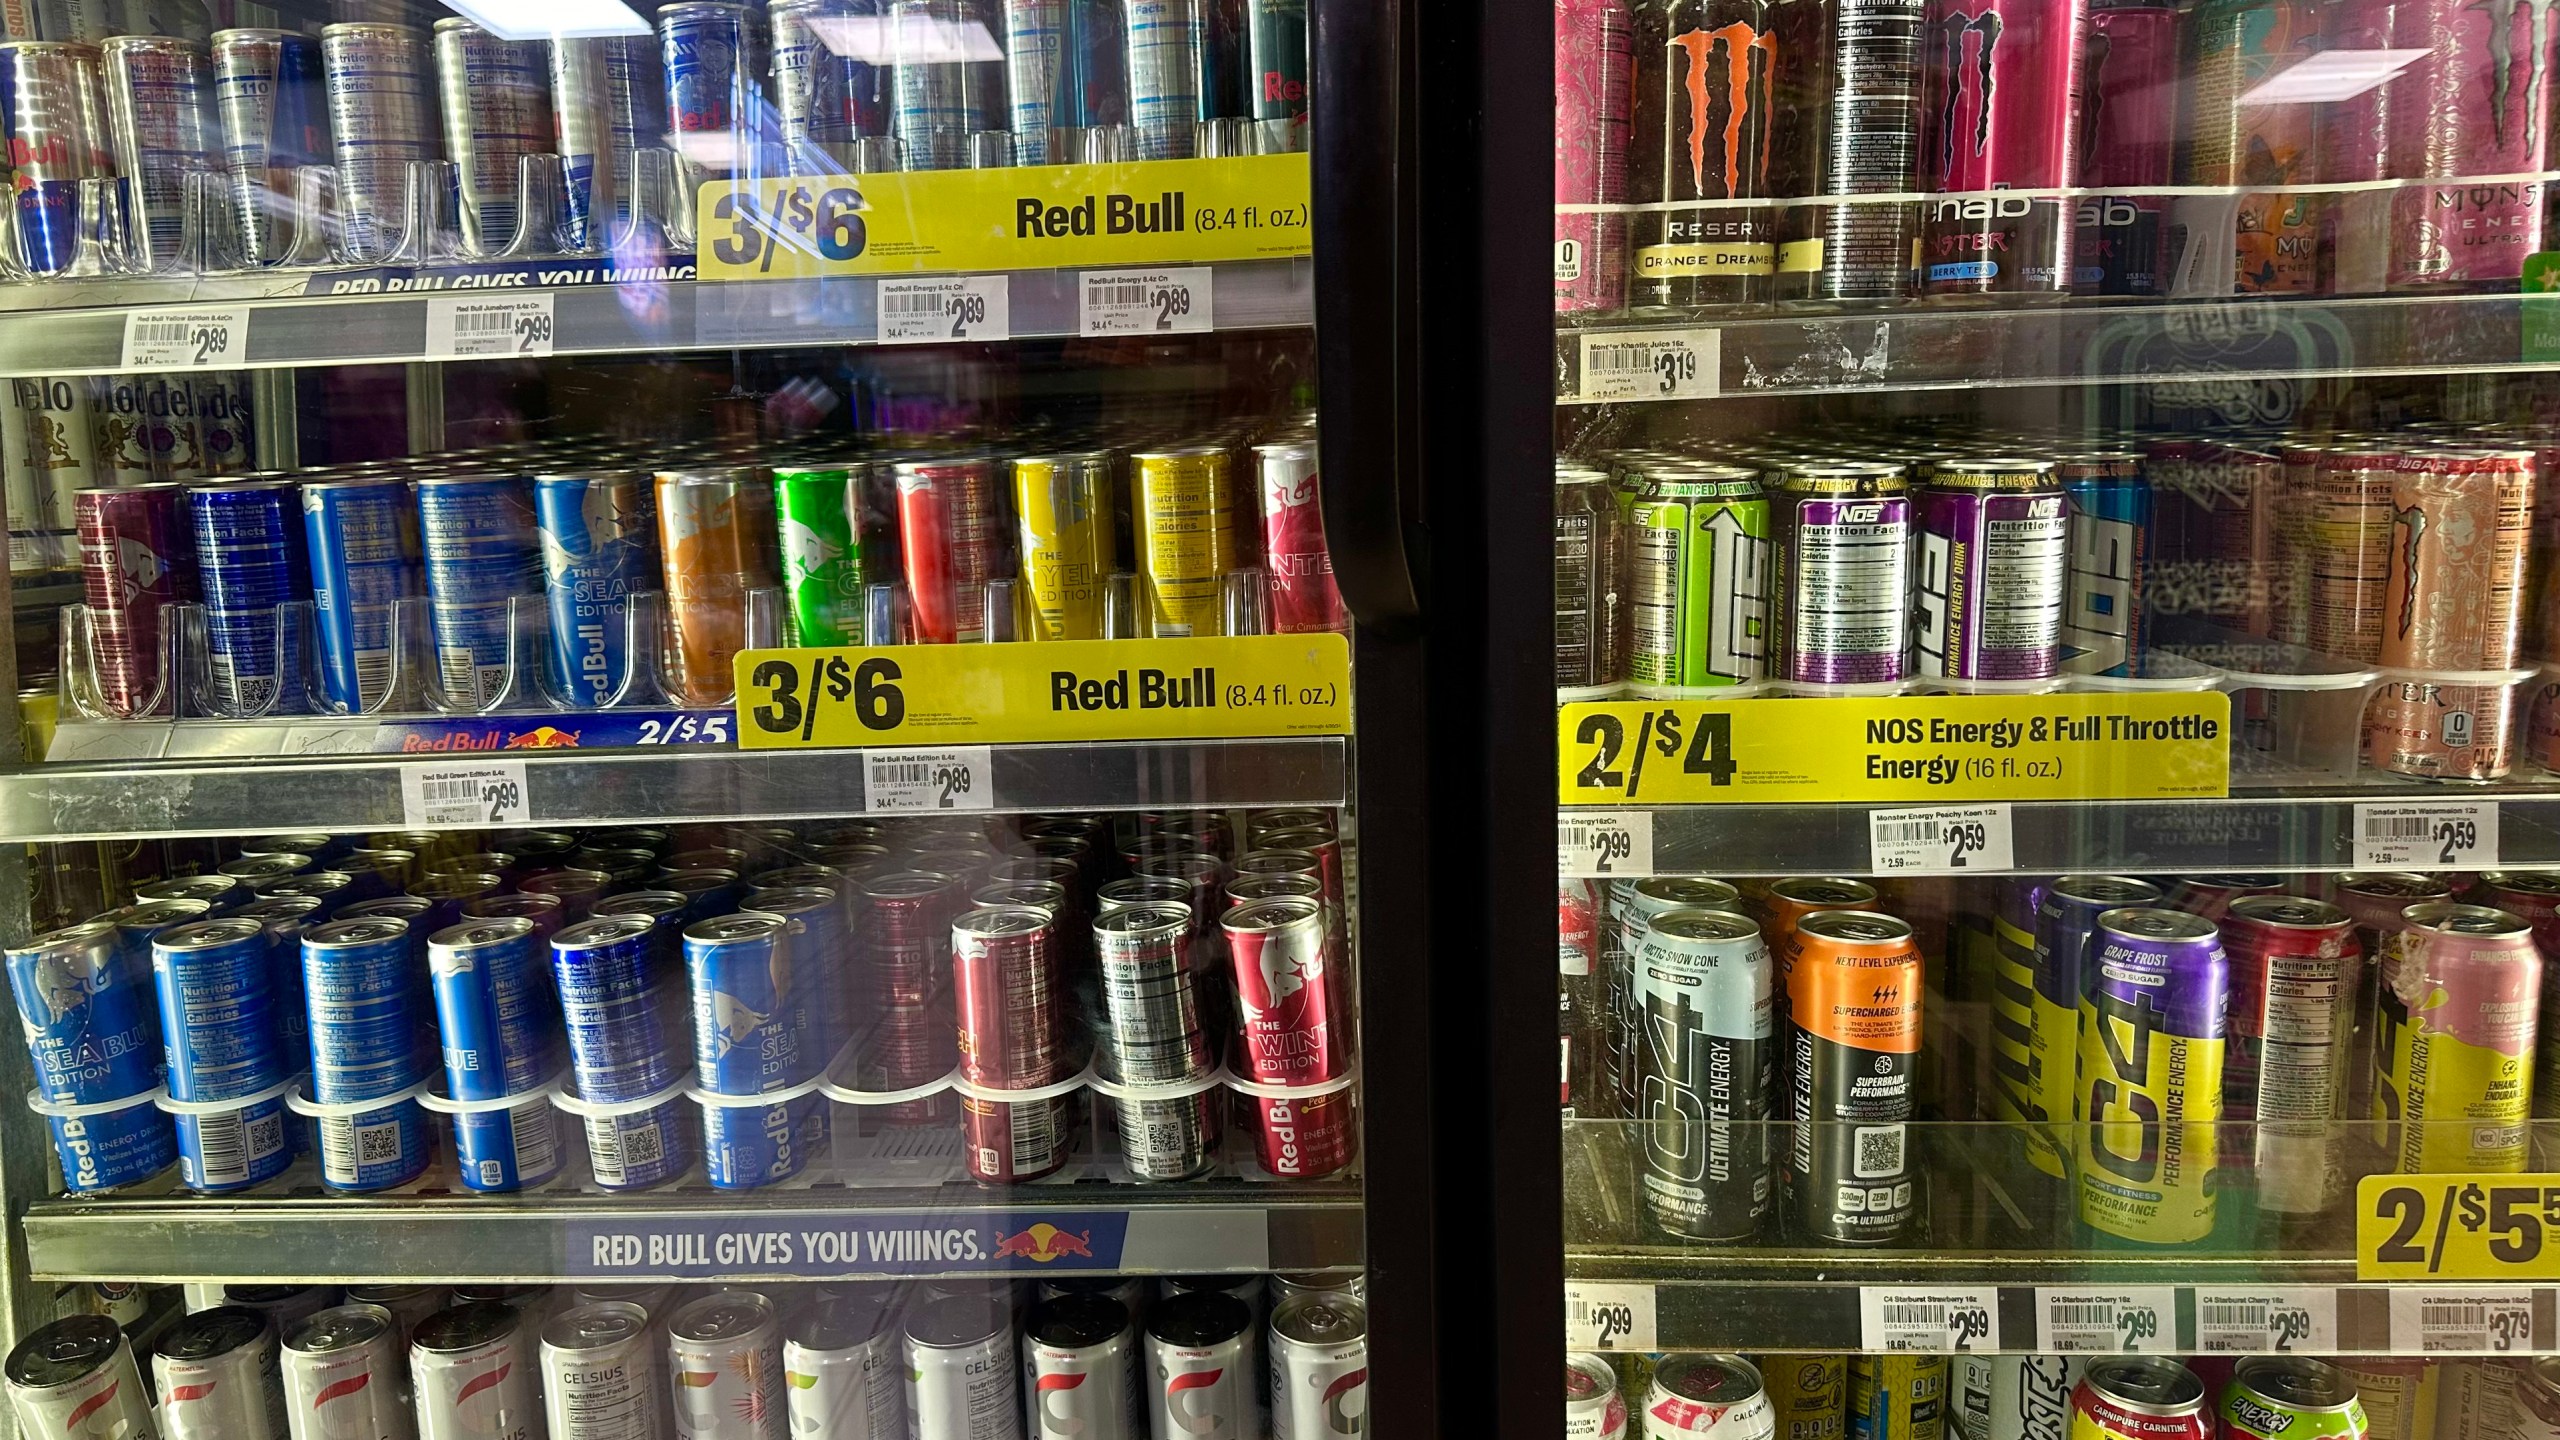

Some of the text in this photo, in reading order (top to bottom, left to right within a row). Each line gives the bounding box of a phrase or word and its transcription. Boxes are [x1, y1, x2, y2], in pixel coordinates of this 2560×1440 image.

[1017, 192, 1308, 238] Red Bull (8.4 fl. oz.)
[713, 186, 866, 272] 3/$6
[1645, 256, 1708, 267] ORANGE
[1934, 266, 1989, 276] BERRY TEA
[1658, 482, 1755, 496] ENHANCED MENTAL
[1813, 479, 1858, 492] ENERGY
[1997, 474, 2039, 487] ENERGY
[1838, 506, 1880, 523] NOS
[1038, 552, 1063, 560] THE
[1802, 552, 1829, 560] Calories
[572, 568, 600, 577] THE
[1952, 542, 1966, 619] ENERGY DRINK
[575, 579, 628, 602] SEA
[753, 656, 905, 741] 3/$6
[1051, 668, 1336, 711] Red Bull (8.4 fl. oz.)
[1866, 714, 2218, 748] NOS Energy & Full Throttle
[1576, 710, 1737, 797] 2/$4
[1866, 754, 2062, 784] Energy (16 fl. oz.)
[1643, 942, 1720, 967] ARCTIC SNOW CONE
[1835, 956, 1857, 967] NEXT
[1859, 957, 1882, 968] LEVEL
[2104, 944, 2168, 966] GRAPE FROST
[2272, 960, 2313, 970] Nutrition
[1650, 970, 1697, 985] ZERO SUGAR
[2105, 968, 2160, 984] ZERO SUGAR
[2270, 985, 2337, 995] Calories 10
[1833, 1006, 1899, 1017] SUPERCHARGED
[759, 1022, 784, 1037] THE
[1254, 1021, 1280, 1030] THE
[39, 1038, 64, 1049] THE
[43, 1043, 102, 1072] SEA
[1260, 1053, 1320, 1071] EDITION
[2409, 1035, 2429, 1080] ENERGY
[49, 1063, 111, 1086] EDITION
[1856, 1074, 1904, 1087] SUPERBRAIN
[1643, 990, 1705, 1183] C4
[1850, 1084, 1906, 1097] PERFORMANCE
[2090, 990, 2166, 1184] C4
[1795, 1031, 1812, 1174] ULTIMATE ENERGY
[1710, 1042, 1730, 1182] ULTIMATE ENERGY
[2163, 1039, 2187, 1187] PERFORMANCE ENERGY
[99, 1131, 138, 1151] ENERGY
[1872, 1192, 1888, 1202] ZERO
[2084, 1188, 2158, 1217] PERFORMANCE
[2118, 1188, 2157, 1201] FITNESS
[1832, 1213, 1895, 1225] C4 ULTIMATE
[593, 1229, 986, 1266] RED BULL GIVES YOU WIIINGS.
[564, 1366, 623, 1384] CELSIUS
[569, 1384, 629, 1399] Nutrition Facts
[2093, 1404, 2188, 1432] CARNIPURE CARNITINE
[2232, 1398, 2293, 1430] ENERGY
